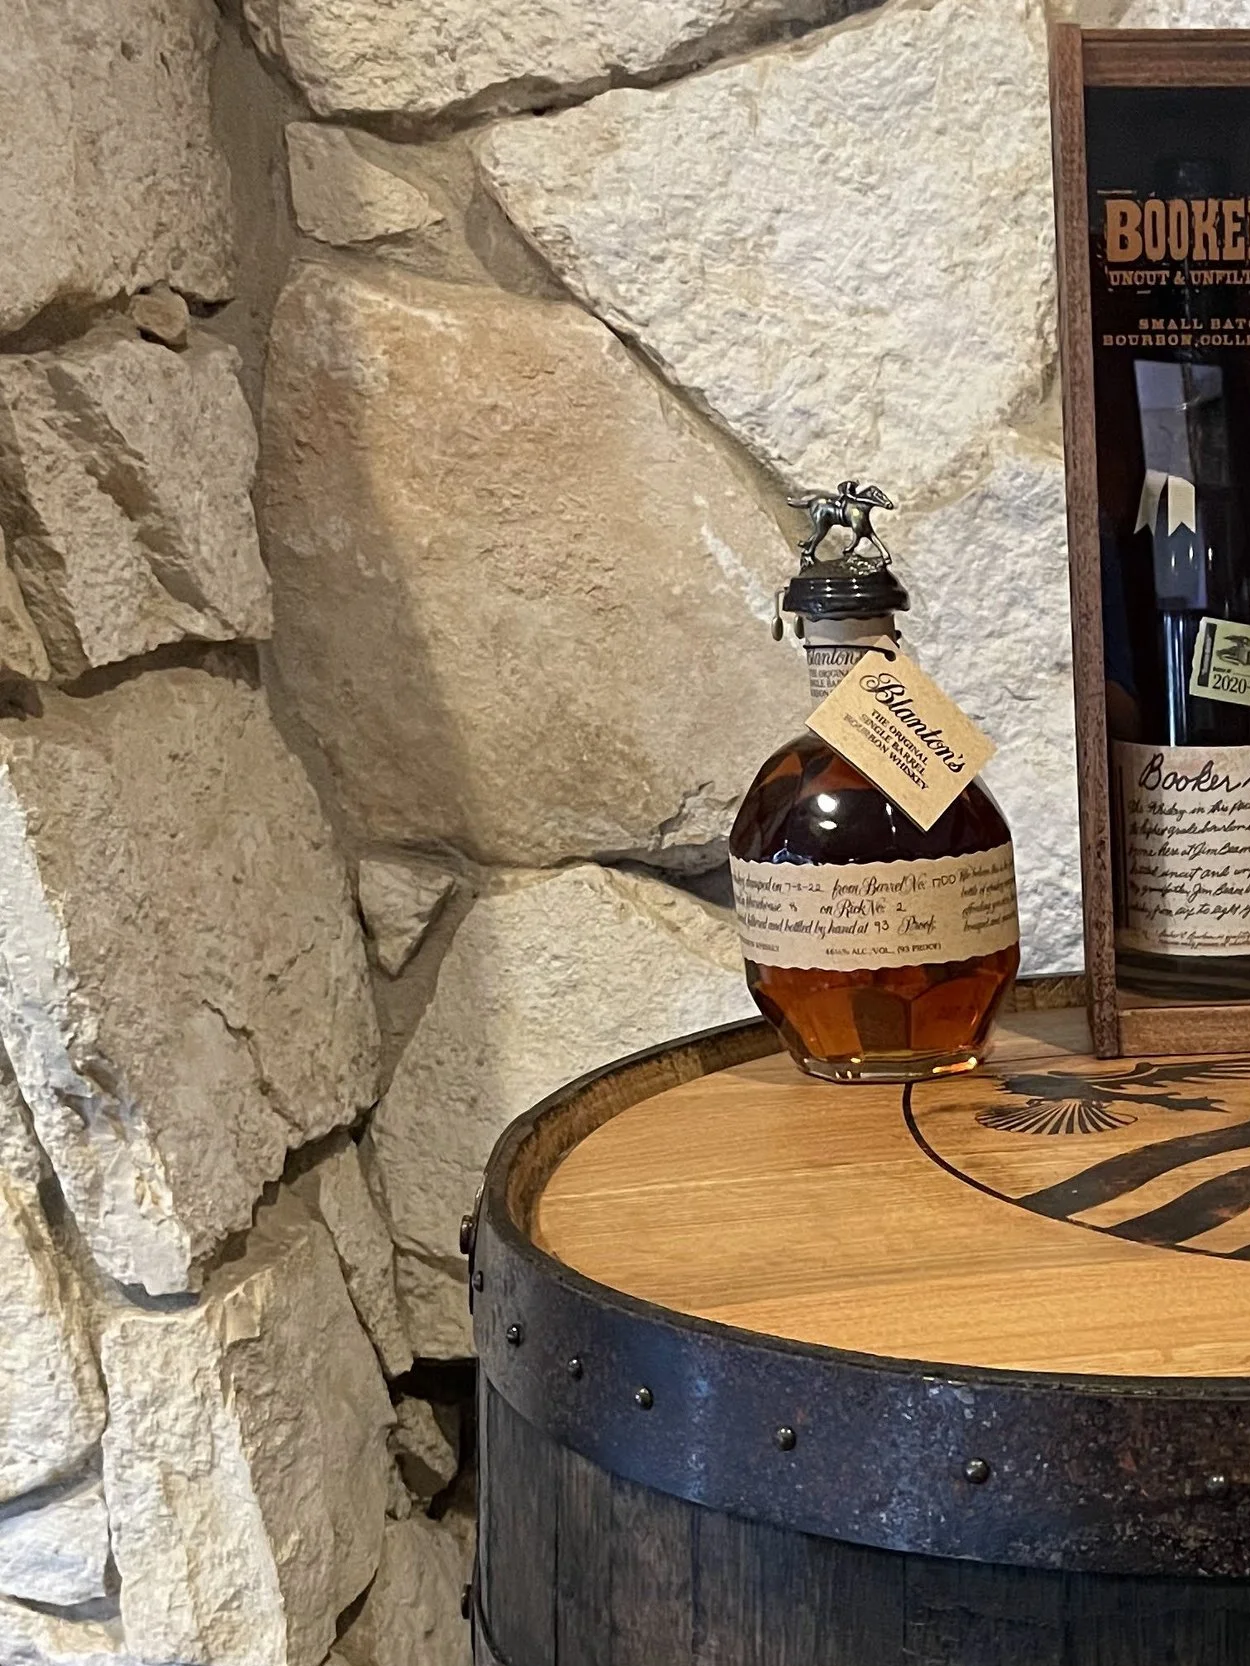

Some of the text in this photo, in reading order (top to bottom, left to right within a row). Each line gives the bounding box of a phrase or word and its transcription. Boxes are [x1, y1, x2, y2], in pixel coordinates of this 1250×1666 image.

[1109, 270, 1169, 286] UNCUT
[1173, 270, 1185, 285] &
[1139, 318, 1203, 330] SMALL
[1103, 334, 1193, 346] BOURBON
[860, 673, 965, 773] Blanton's
[861, 713, 925, 776] SINGLE BARREL
[871, 708, 928, 766] THE ORIGINAL
[844, 712, 929, 790] BOURBON WHISKEY
[859, 876, 903, 896] Barrel
[820, 905, 833, 915] on
[833, 898, 865, 919] Rick
[896, 902, 907, 912] 2
[828, 918, 858, 934] hand
[858, 921, 869, 934] at
[874, 920, 889, 932] 93
